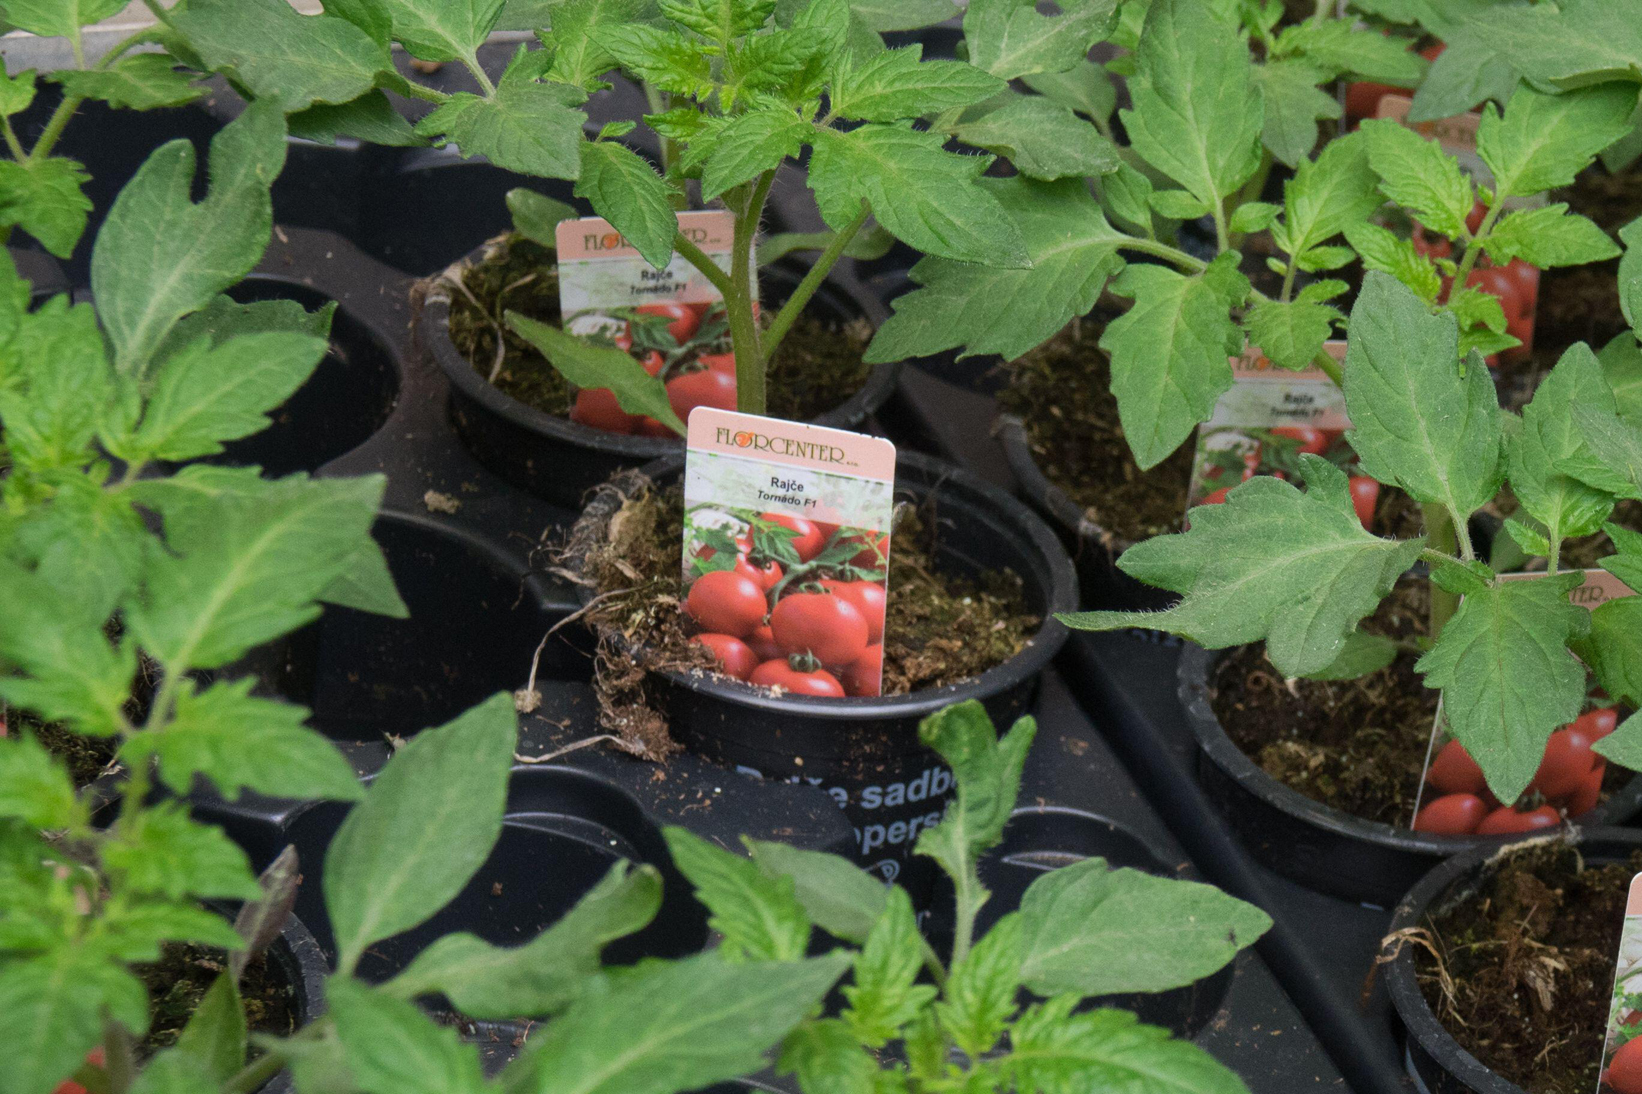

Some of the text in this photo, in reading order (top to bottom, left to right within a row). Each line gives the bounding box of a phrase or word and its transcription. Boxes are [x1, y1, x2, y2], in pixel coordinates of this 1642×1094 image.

[716, 427, 845, 465] FLORCENTER
[771, 477, 804, 493] Rajče
[757, 490, 817, 508] Tornádo F1
